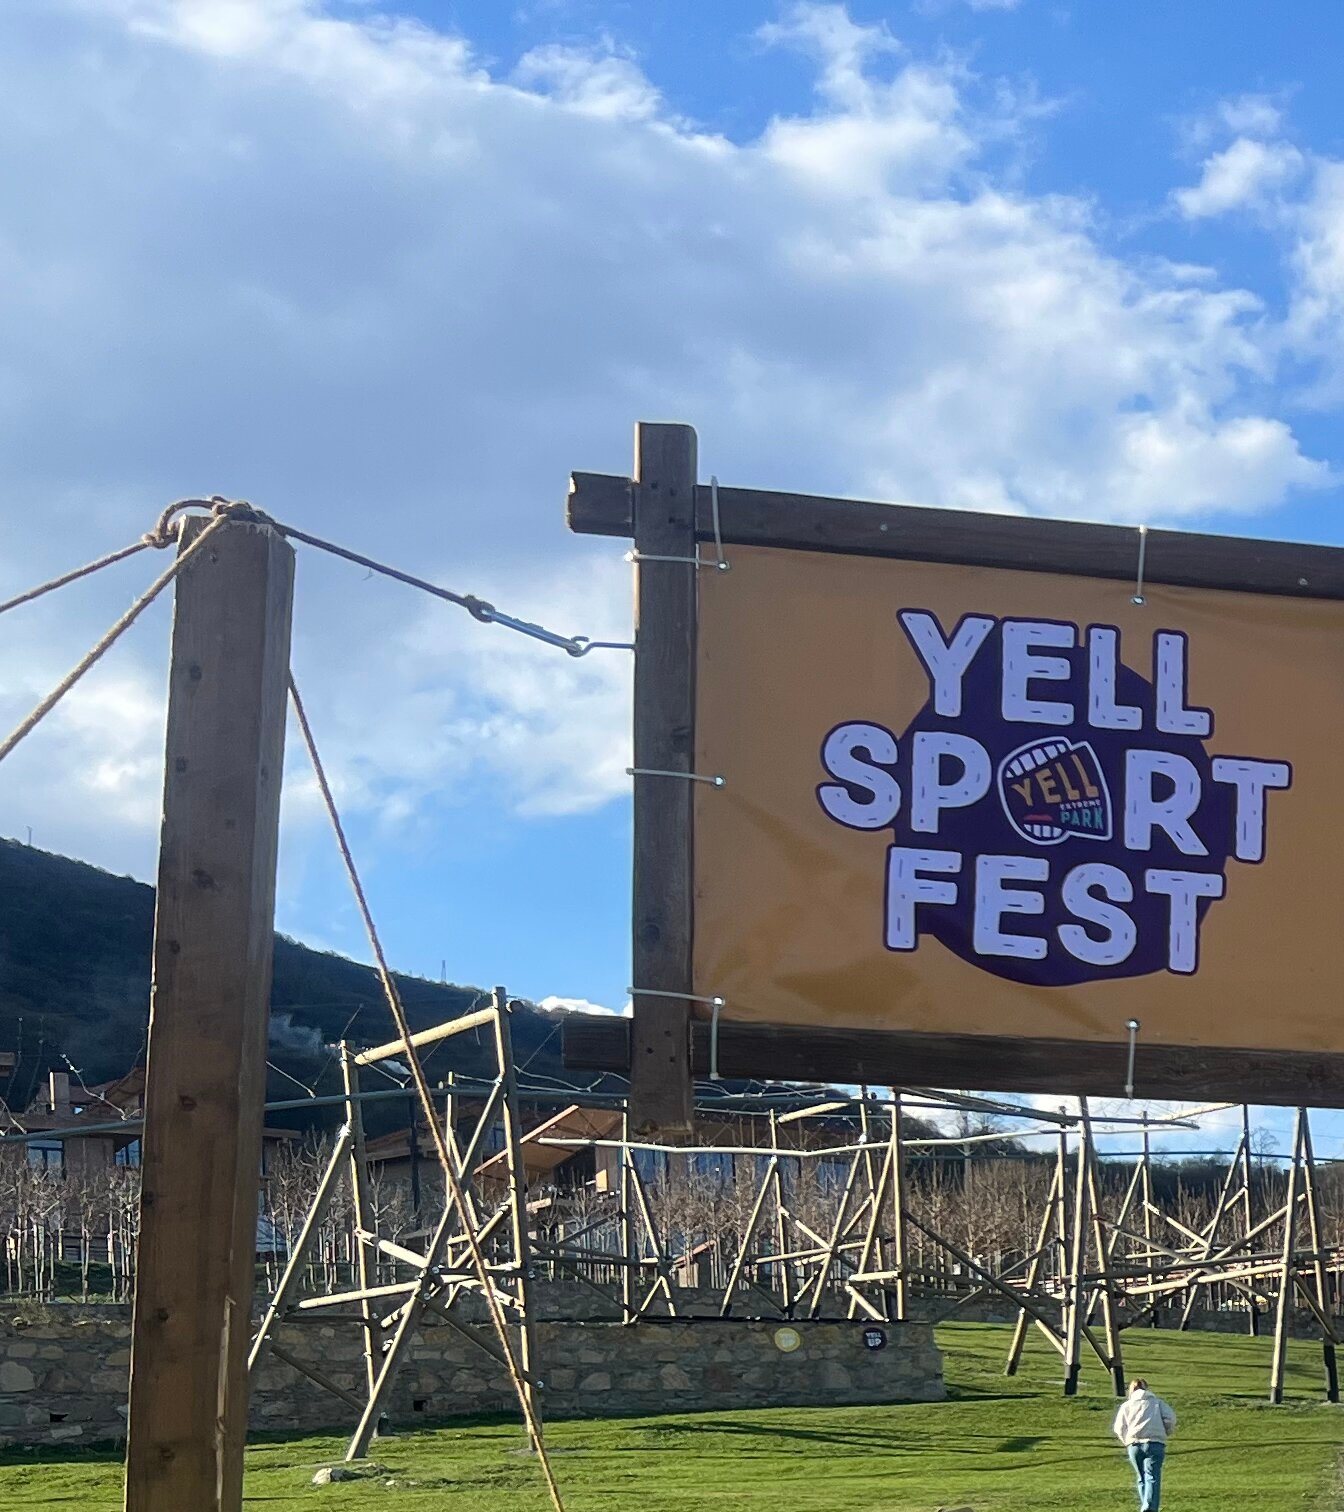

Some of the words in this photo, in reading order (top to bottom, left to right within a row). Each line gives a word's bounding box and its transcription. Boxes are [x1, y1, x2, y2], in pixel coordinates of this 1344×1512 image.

[901, 612, 1212, 737] YELL
[818, 724, 1290, 861] SPORT
[1011, 754, 1099, 807] YELL
[1060, 807, 1104, 830] PARK
[886, 846, 1224, 973] FEST
